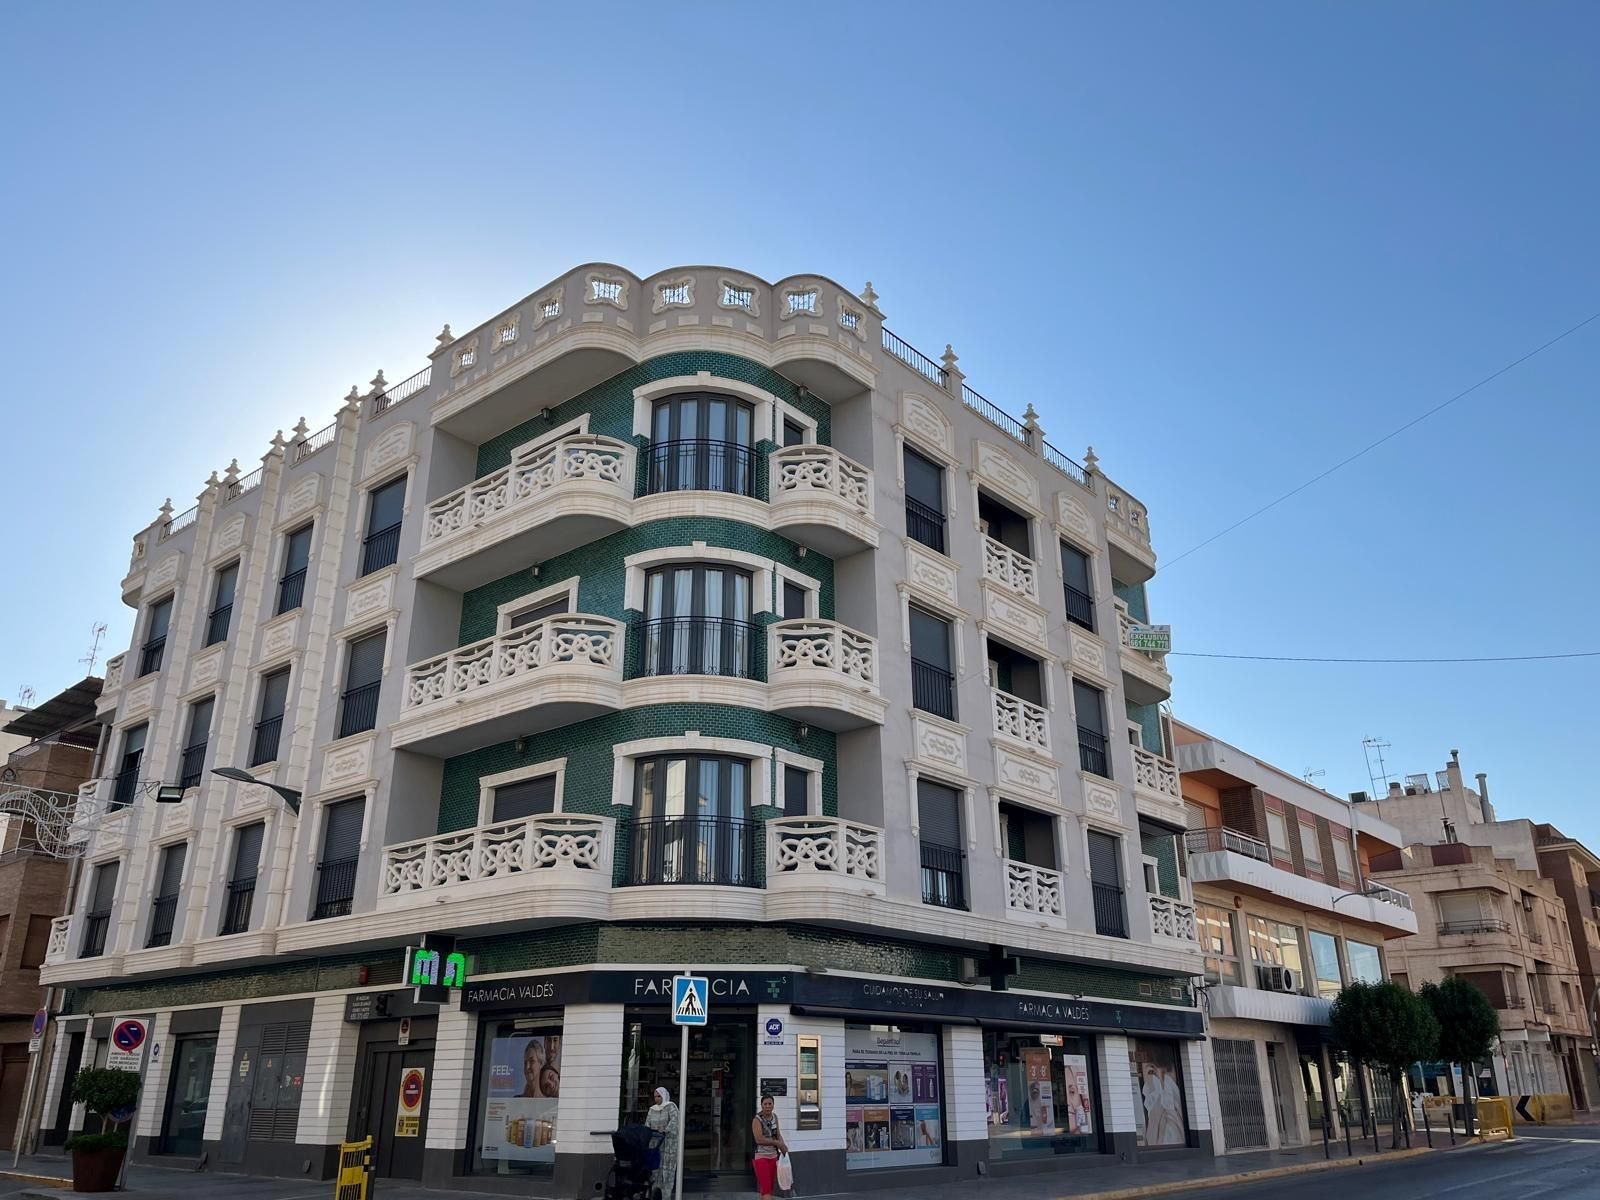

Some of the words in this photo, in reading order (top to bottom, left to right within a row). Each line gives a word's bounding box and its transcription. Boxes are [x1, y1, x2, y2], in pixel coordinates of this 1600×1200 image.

[1130, 633, 1169, 641] EXCLUSIVA
[468, 986, 516, 1002] FARMACIA
[519, 980, 554, 999] VALDÉS
[634, 978, 750, 995] FARCIA
[1018, 1001, 1060, 1017] FARMACA
[768, 1023, 780, 1031] ADT
